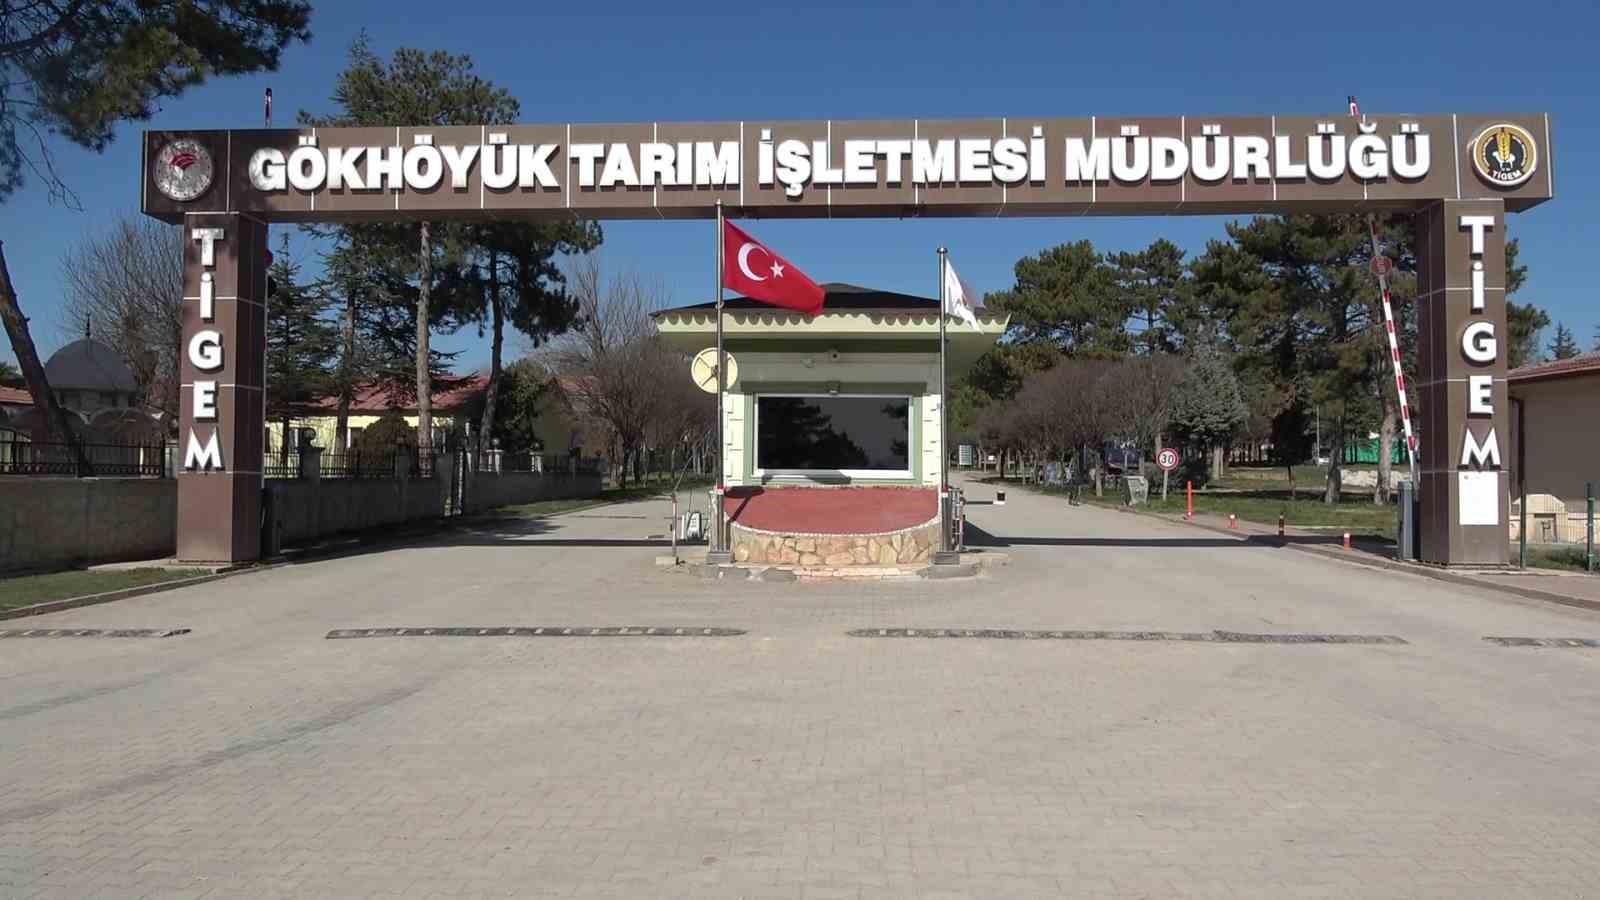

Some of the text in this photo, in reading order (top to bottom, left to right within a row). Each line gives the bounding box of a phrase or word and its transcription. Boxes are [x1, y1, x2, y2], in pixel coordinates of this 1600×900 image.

[249, 132, 560, 193] GÖKHÖYÜK
[570, 140, 740, 190] TARIM
[758, 126, 1046, 198] İŞLETMESİ
[1065, 122, 1431, 184] MÜDÜRLÜĞÜ
[185, 227, 224, 471] TİGEM
[1459, 215, 1501, 470] TİGEM
[1161, 454, 1174, 464] 30
